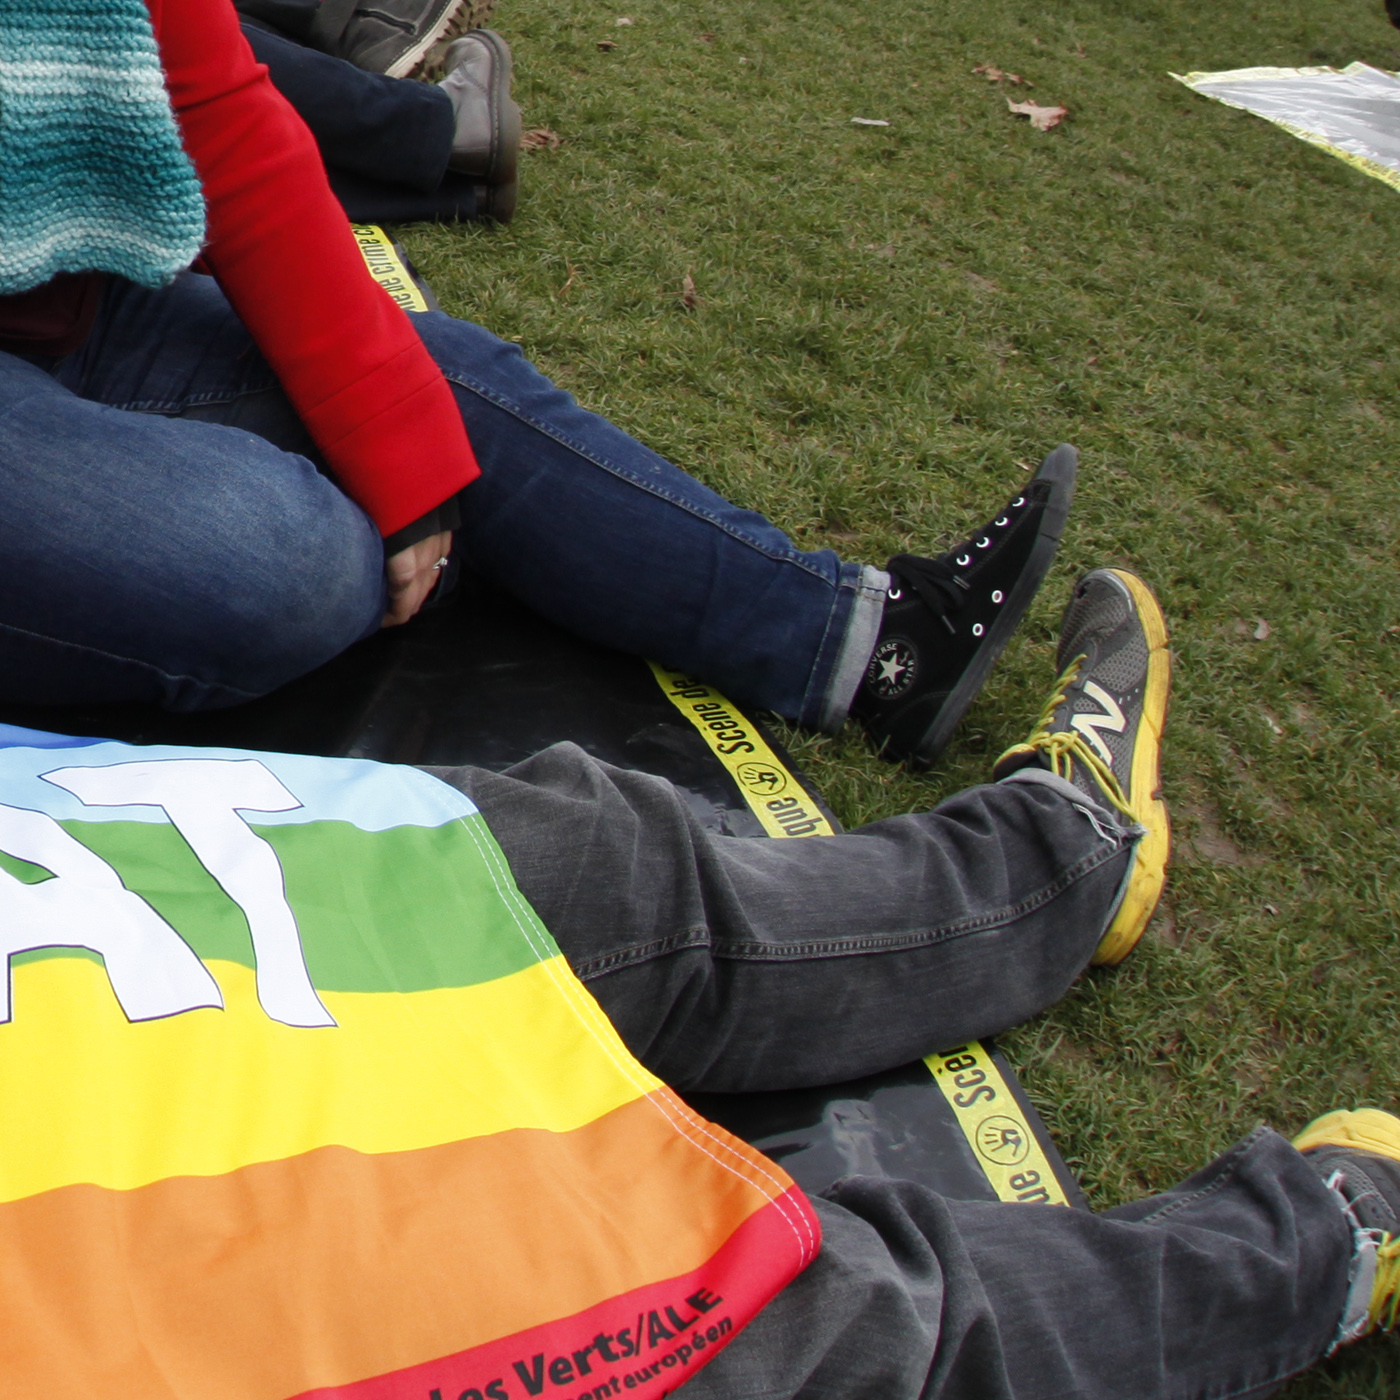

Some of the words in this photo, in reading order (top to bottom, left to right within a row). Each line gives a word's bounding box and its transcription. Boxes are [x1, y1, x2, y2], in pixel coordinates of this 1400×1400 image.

[691, 701, 755, 756] Scène
[937, 1045, 996, 1109] Scè
[511, 1286, 724, 1398] Verts/ALE
[623, 1315, 733, 1389] européen
